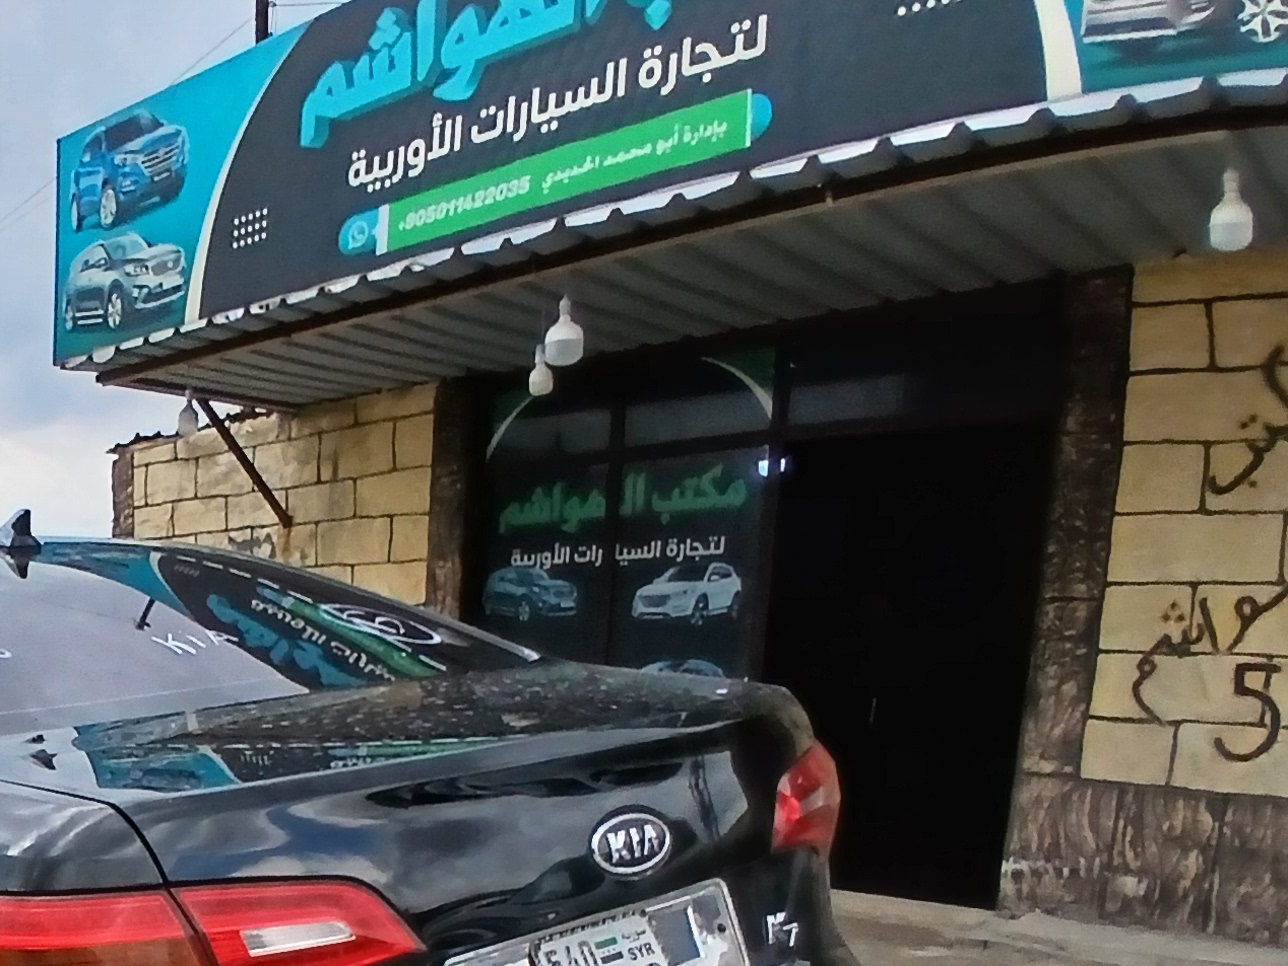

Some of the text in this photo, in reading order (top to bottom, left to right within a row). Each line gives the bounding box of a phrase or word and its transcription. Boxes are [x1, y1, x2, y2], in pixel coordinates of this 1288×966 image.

[348, 14, 768, 193] لتجارة السيارات الأوربية
[683, 119, 728, 146] بإدارة
[603, 142, 652, 167] محمد
[651, 462, 748, 526] مكتب
[666, 535, 726, 562] لتجارة
[606, 823, 660, 864] KIA
[627, 942, 656, 961] SYR
